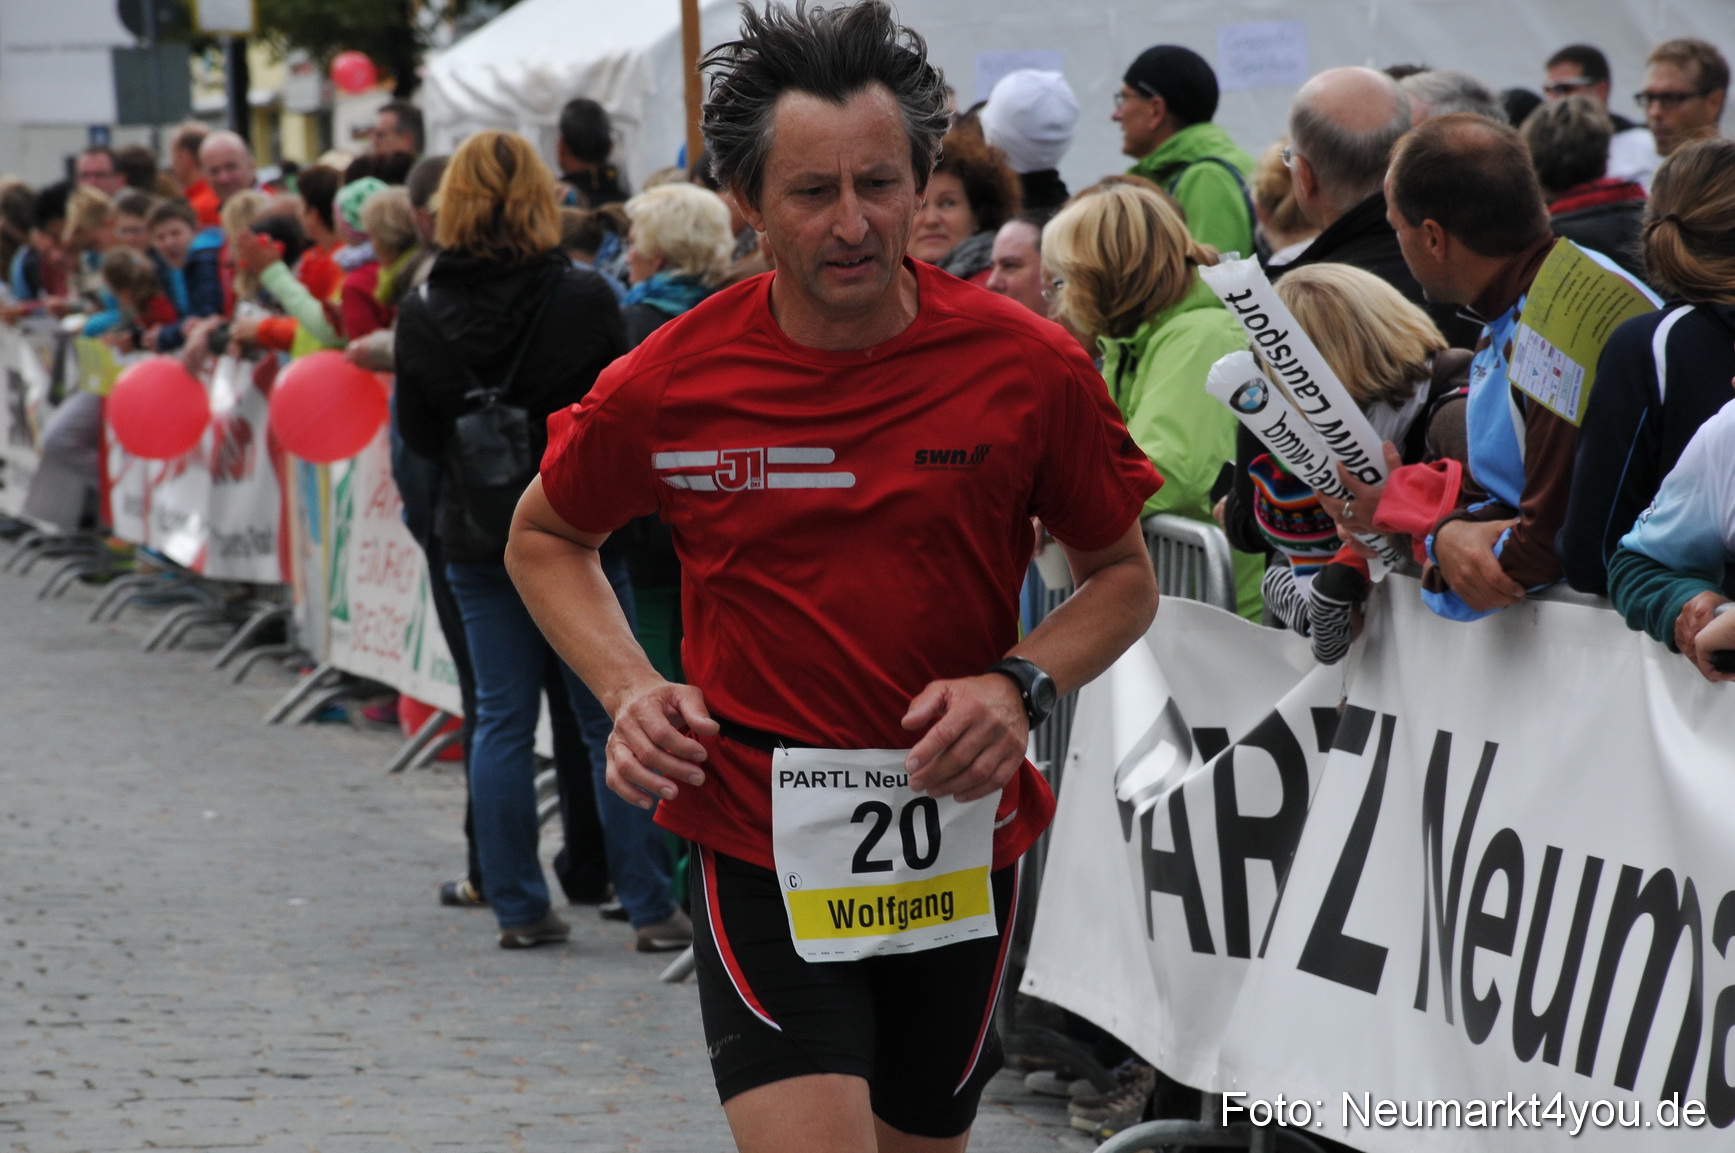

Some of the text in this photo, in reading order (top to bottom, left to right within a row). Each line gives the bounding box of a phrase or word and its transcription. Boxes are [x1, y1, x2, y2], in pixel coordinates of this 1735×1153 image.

[1224, 288, 1383, 485] BMW Laufsport
[914, 449, 967, 465] swn
[779, 770, 912, 788] PARTL Neu
[850, 796, 942, 874] 20
[827, 890, 954, 930] Wolfgang
